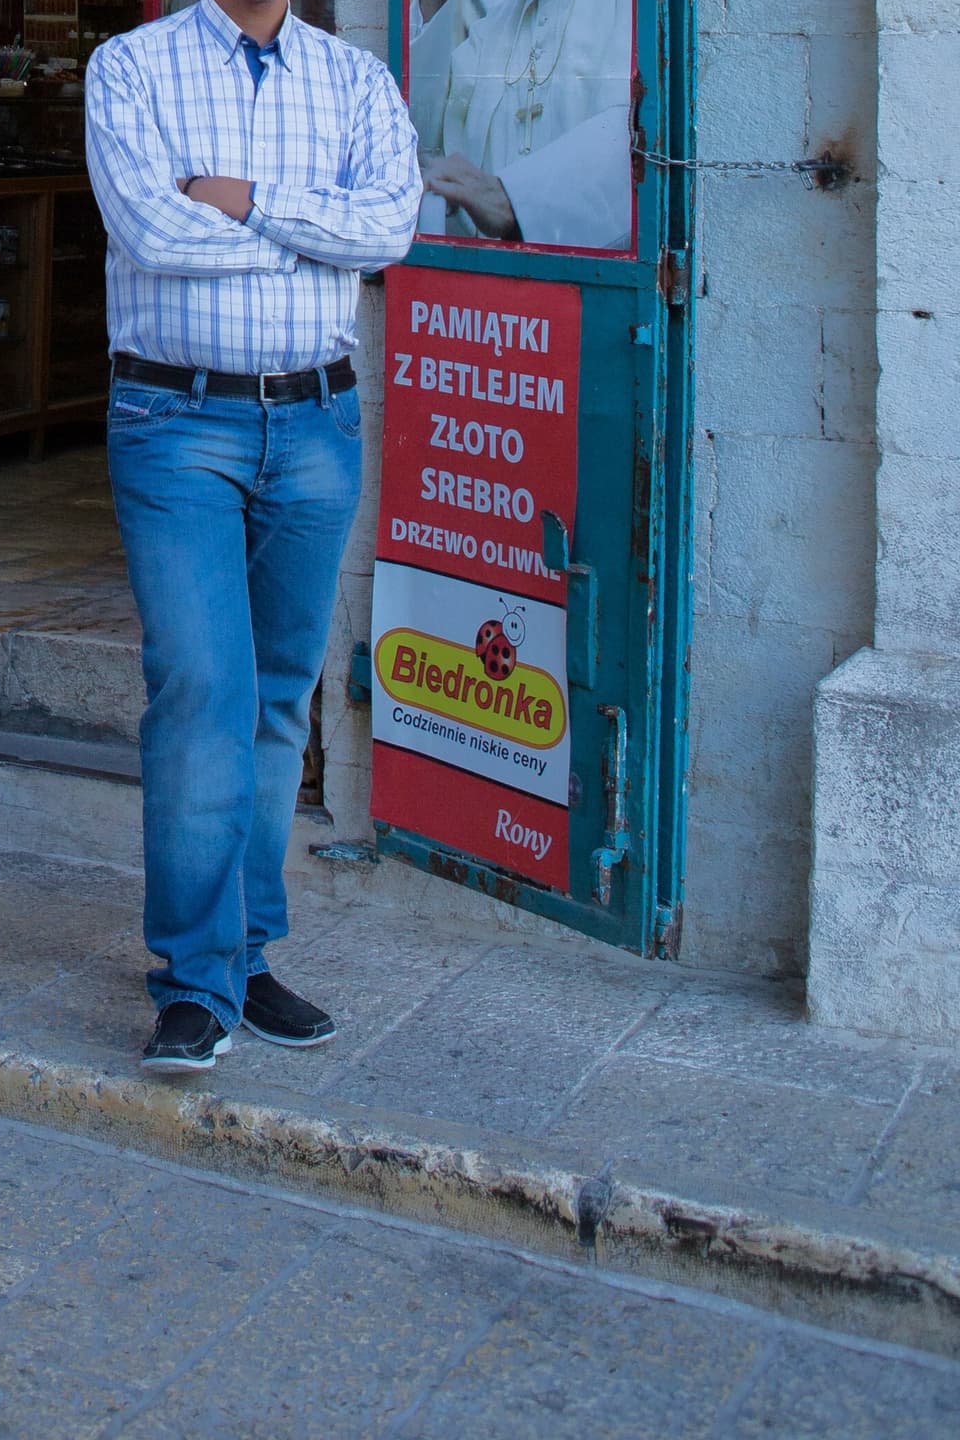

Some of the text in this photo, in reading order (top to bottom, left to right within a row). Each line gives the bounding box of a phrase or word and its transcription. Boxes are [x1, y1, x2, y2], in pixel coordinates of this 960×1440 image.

[411, 300, 549, 356] PAMIĄTKI
[394, 352, 564, 414] Z BETLEJEM
[430, 414, 524, 463] ZŁOTO
[421, 467, 534, 523] SREBRO
[391, 518, 477, 561] DRZEWO
[391, 645, 552, 730] Biedronka
[392, 707, 548, 776] Codziennie niskie ceny
[494, 809, 552, 860] Rony
